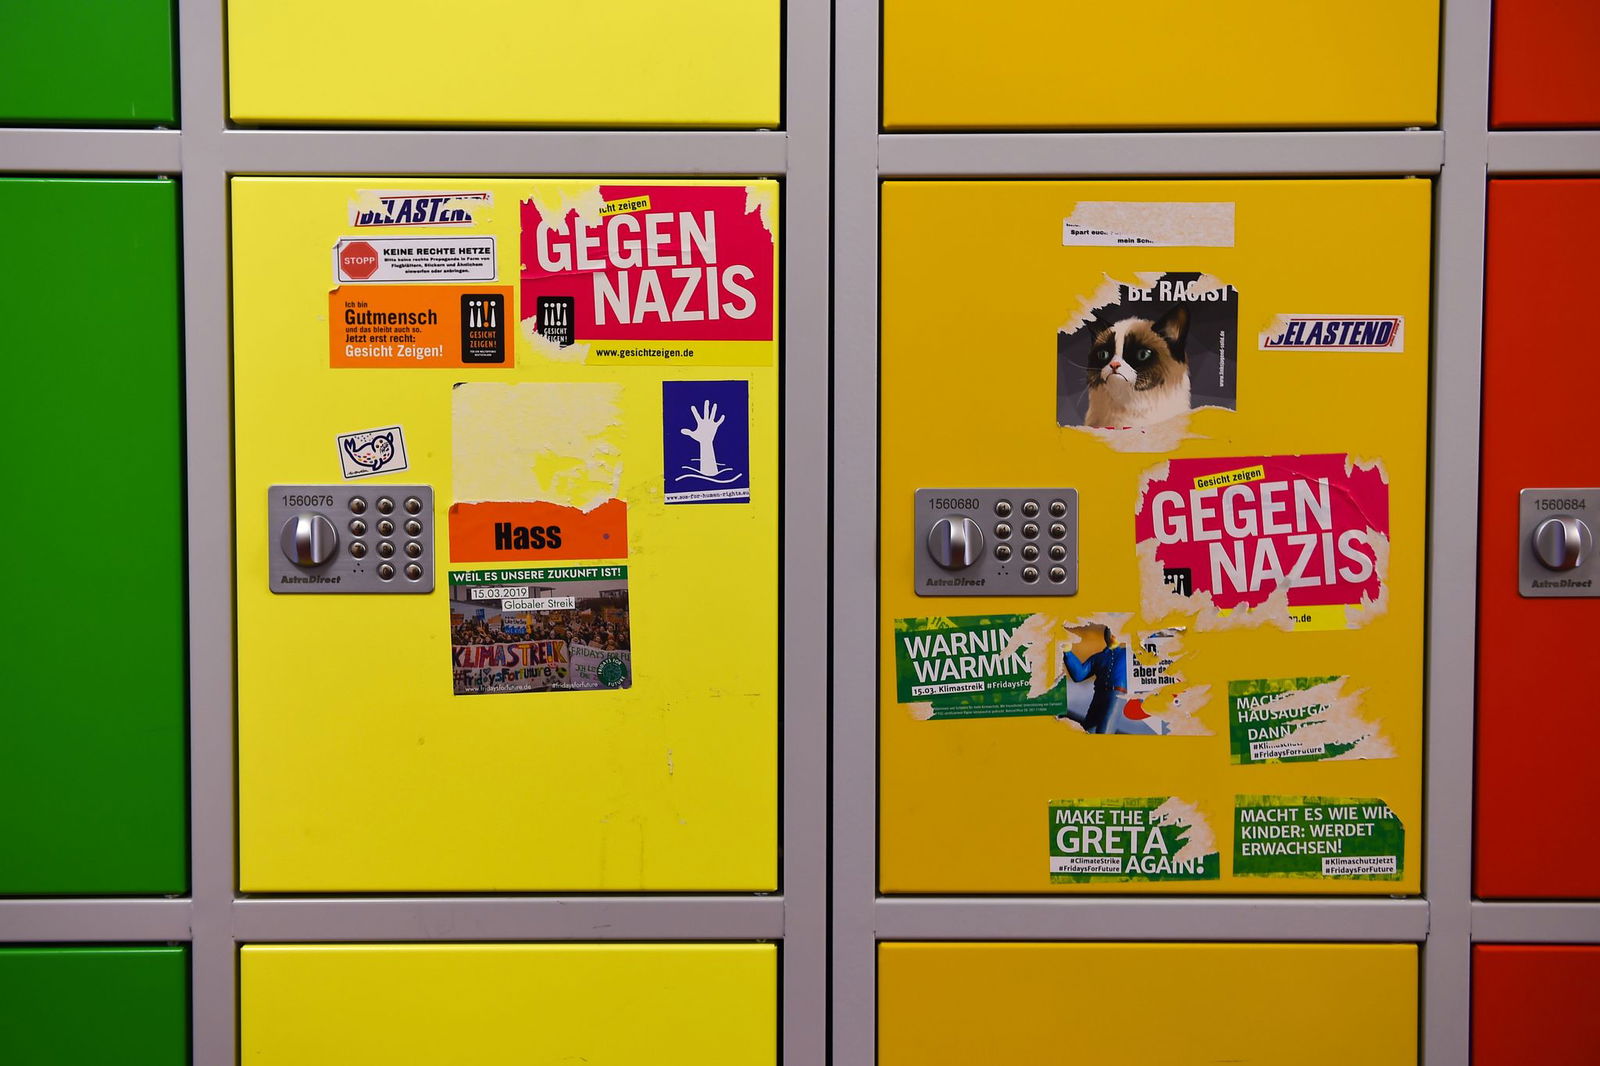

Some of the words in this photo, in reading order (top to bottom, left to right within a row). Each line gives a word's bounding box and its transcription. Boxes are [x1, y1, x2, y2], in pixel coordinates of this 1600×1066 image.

[618, 199, 648, 211] zeigen
[1070, 229, 1090, 237] Spart
[536, 210, 718, 272] GEGEN
[383, 248, 413, 256] KEINE
[417, 247, 455, 255] RECHTE
[459, 246, 491, 254] HETZE
[344, 256, 375, 265] STOPP
[592, 264, 757, 326] NAZIS
[1128, 285, 1152, 302] BE
[345, 309, 438, 325] Gutmensch
[470, 331, 497, 339] GESICHT
[544, 327, 567, 335] GESICHT
[345, 334, 367, 343] Jetzt
[369, 334, 387, 343] erst
[389, 333, 416, 343] recht:
[470, 340, 497, 348] ZEIGEN!
[547, 335, 568, 343] EIGEN!
[345, 344, 393, 357] Gesicht
[397, 344, 443, 360] Zeigen!
[595, 347, 695, 359] www.gesichtzeigen.de
[1196, 474, 1231, 489] Gesicht
[1231, 468, 1262, 483] zeigen
[282, 495, 334, 507] 1560676
[929, 498, 980, 510] 1560680
[1534, 499, 1586, 511] 1560684
[1151, 477, 1333, 545] GEGEN
[494, 522, 563, 551] Hass
[1209, 529, 1374, 596] NAZIS
[280, 575, 342, 584] AstraDirect
[453, 572, 481, 583] WEIL
[484, 571, 498, 582] ES
[501, 570, 544, 581] UNSERE
[547, 568, 597, 580] ZUKUNFT
[600, 567, 621, 578] IST!
[925, 577, 986, 587] AstraDirect
[1531, 578, 1593, 588] AstraDirect
[473, 587, 527, 599] 15.03.2019
[503, 599, 544, 610] Globaler
[547, 598, 574, 609] Streik
[904, 627, 1020, 660] WARNIN
[452, 641, 568, 669] KLIMASTREIK
[1133, 666, 1157, 678] aber
[464, 682, 532, 693] www.fridaysforfuture.de
[914, 686, 937, 696] 15.03.
[938, 682, 984, 694] Klimastreik
[1247, 725, 1291, 741] DANN
[1055, 809, 1105, 825] MAKE
[1109, 810, 1143, 825] THE
[1240, 808, 1299, 823] MACHT
[1304, 807, 1323, 821] ES
[1327, 806, 1358, 820] WIE
[1361, 806, 1394, 820] WIR
[1241, 825, 1305, 840] KINDER:
[1309, 822, 1375, 838] WERDET
[1056, 825, 1169, 855] GRETA
[1241, 838, 1343, 857] ERWACHSEN!
[1070, 857, 1120, 866] #ClimateStrike
[1125, 855, 1205, 875] AGAIN!
[1325, 856, 1394, 866] #KlimaschutzJetzt
[1058, 865, 1120, 873] #FridaysForFuture
[1325, 865, 1394, 876] #FridaysForFuture
